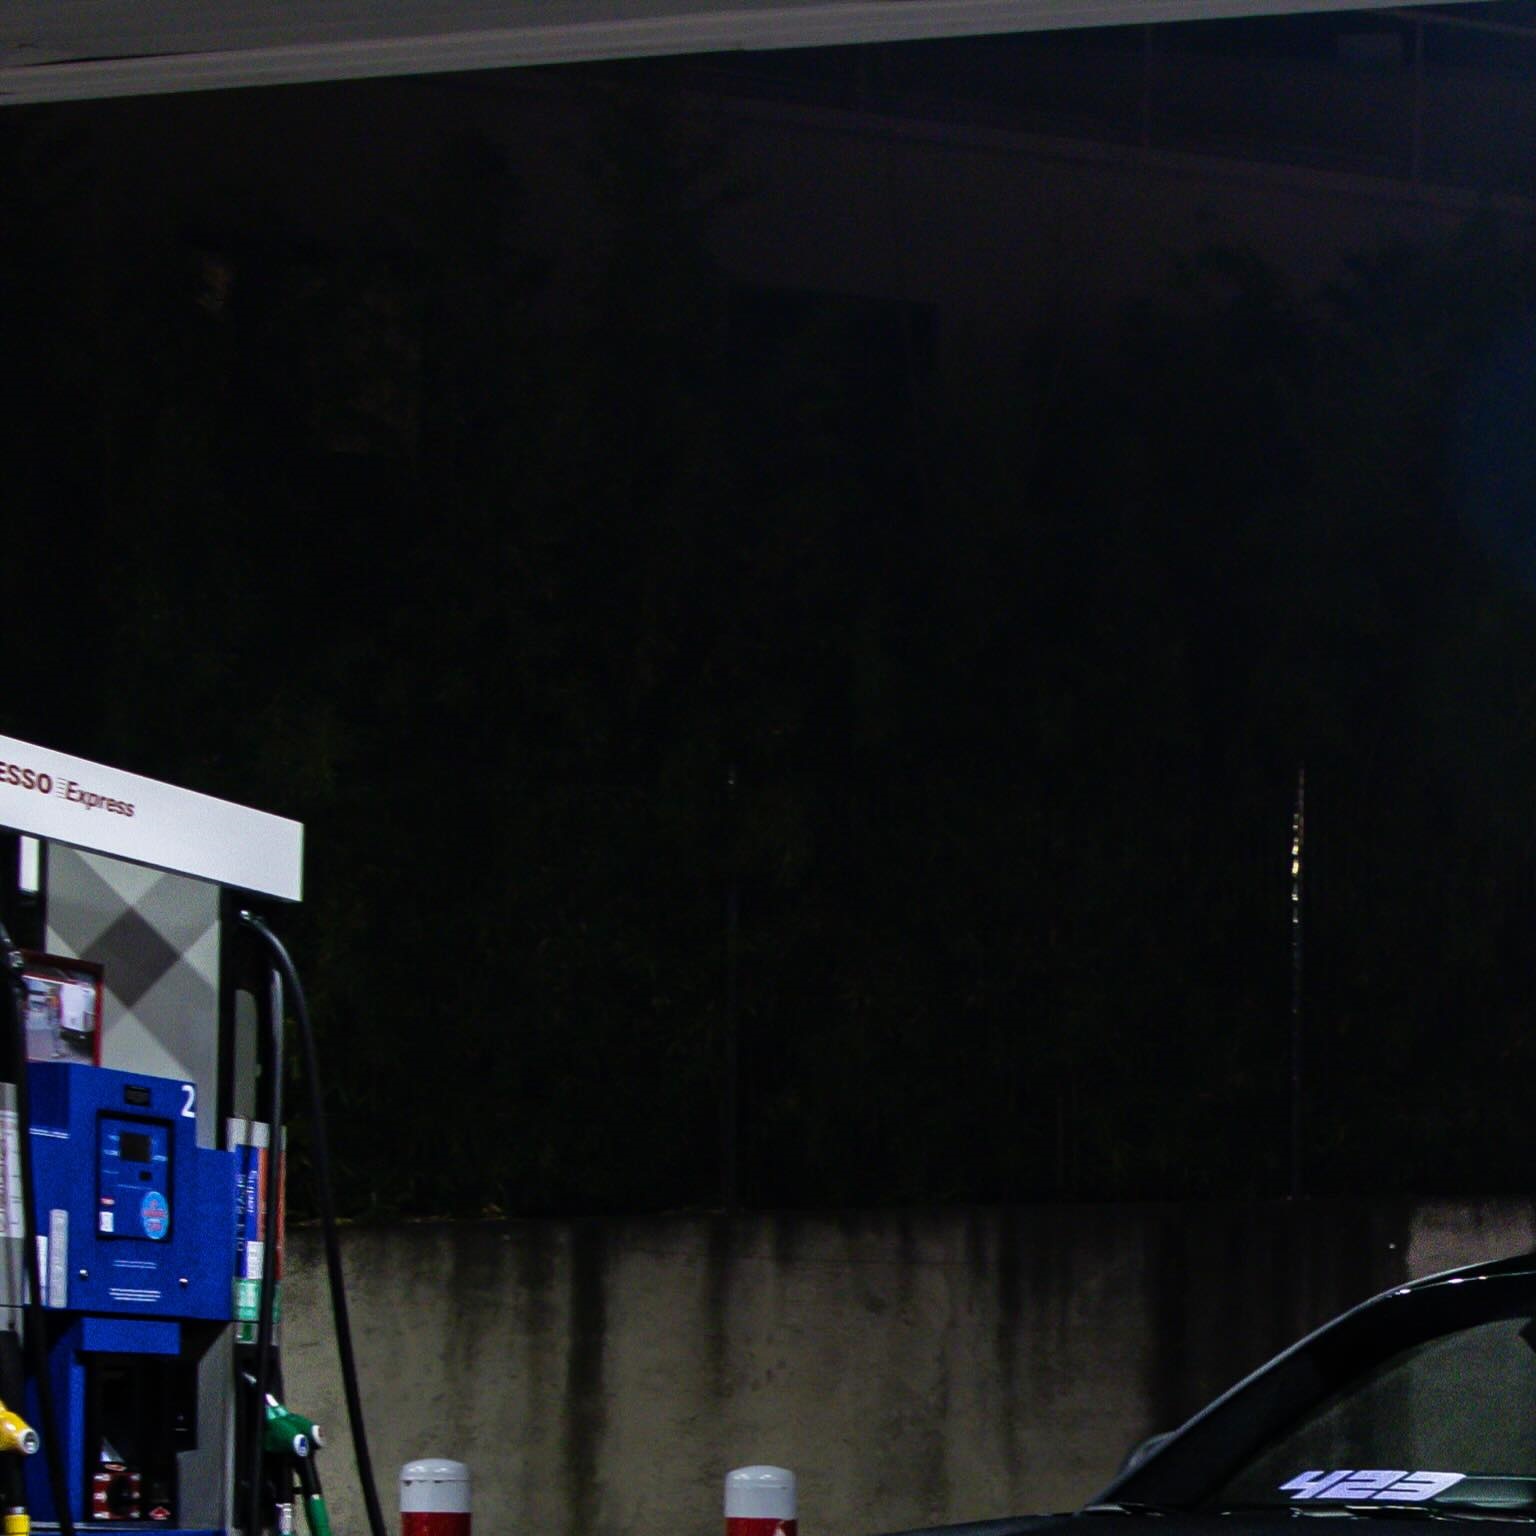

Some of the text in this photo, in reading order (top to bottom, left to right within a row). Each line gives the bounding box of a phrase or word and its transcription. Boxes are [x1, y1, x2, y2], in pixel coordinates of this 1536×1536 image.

[65, 780, 135, 817] Express
[181, 1084, 196, 1118] 2
[1278, 1469, 1467, 1501] 423
